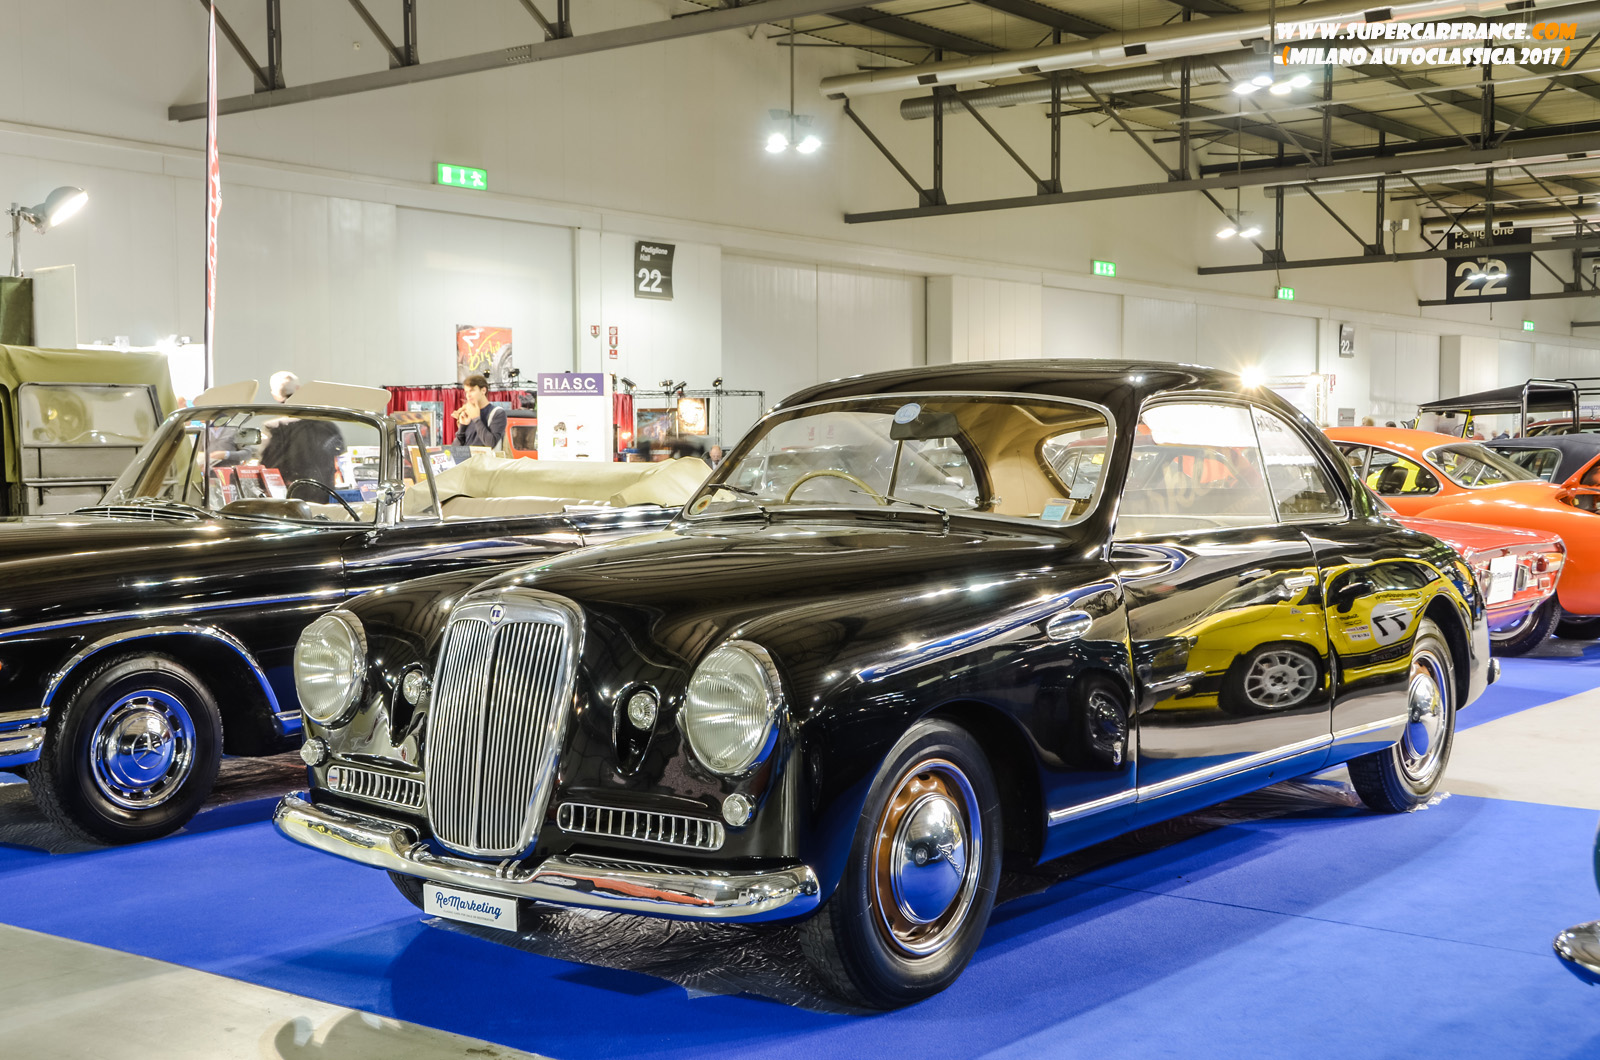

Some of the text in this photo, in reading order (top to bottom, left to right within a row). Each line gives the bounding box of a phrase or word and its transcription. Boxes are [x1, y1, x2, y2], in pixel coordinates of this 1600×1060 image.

[641, 245, 668, 255] Padiglione
[638, 268, 663, 293] 22
[1453, 258, 1508, 298] 22
[1341, 339, 1350, 354] 22
[543, 377, 598, 390] R.I.A.S.C.
[435, 891, 503, 920] ReMarketing
